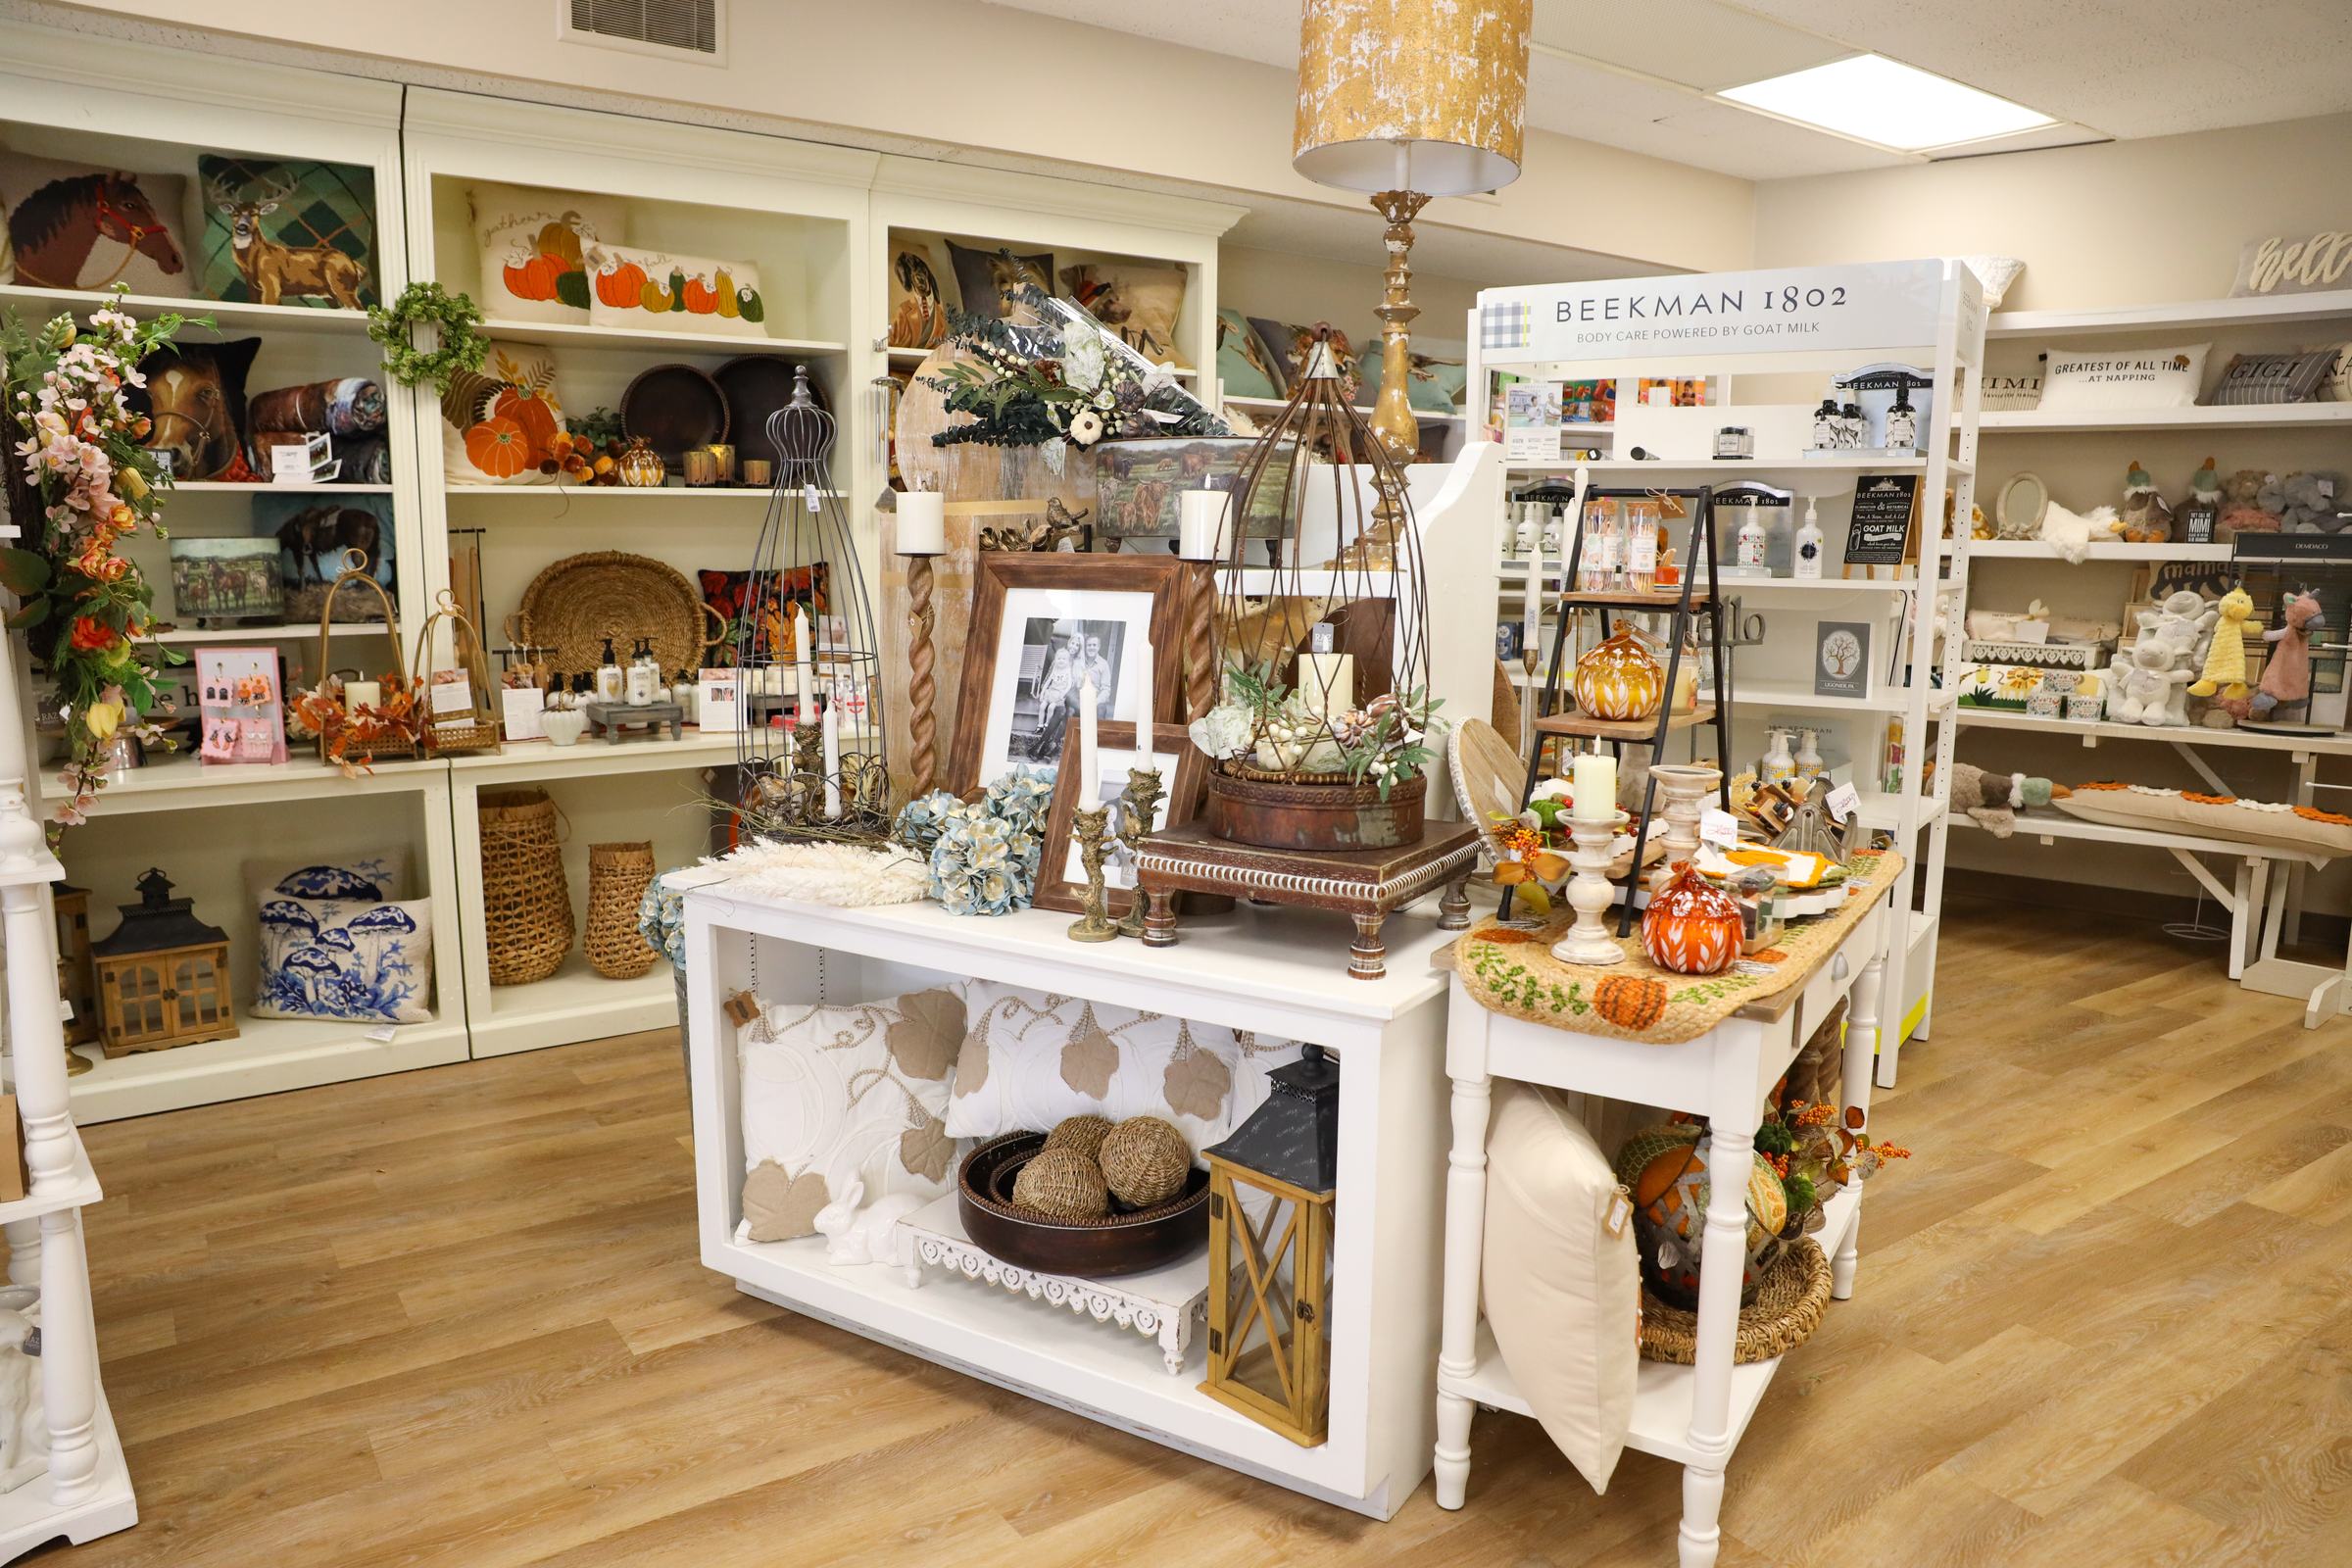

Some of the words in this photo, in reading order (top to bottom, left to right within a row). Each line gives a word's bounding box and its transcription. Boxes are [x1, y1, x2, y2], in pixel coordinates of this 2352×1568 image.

[2249, 231, 2352, 293] hell
[1556, 290, 1743, 322] BEEKMAN
[1763, 286, 1847, 313] 1802
[1576, 331, 1612, 343] BODY
[1615, 329, 1649, 341] CARE
[1653, 326, 1718, 340] POWERED
[1722, 325, 1740, 336] BY
[1742, 323, 1782, 335] GOAT
[1788, 321, 1820, 333] MILK
[2054, 362, 2111, 375] GREATEST
[2115, 361, 2132, 370] OF
[2133, 361, 2156, 370] ALL
[2230, 362, 2302, 379] GIGI
[1845, 380, 1899, 390] BEEKMAN
[2106, 373, 2156, 382] NAPPING
[2188, 517, 2211, 533] MIMI
[41, 712, 59, 721] RAZ
